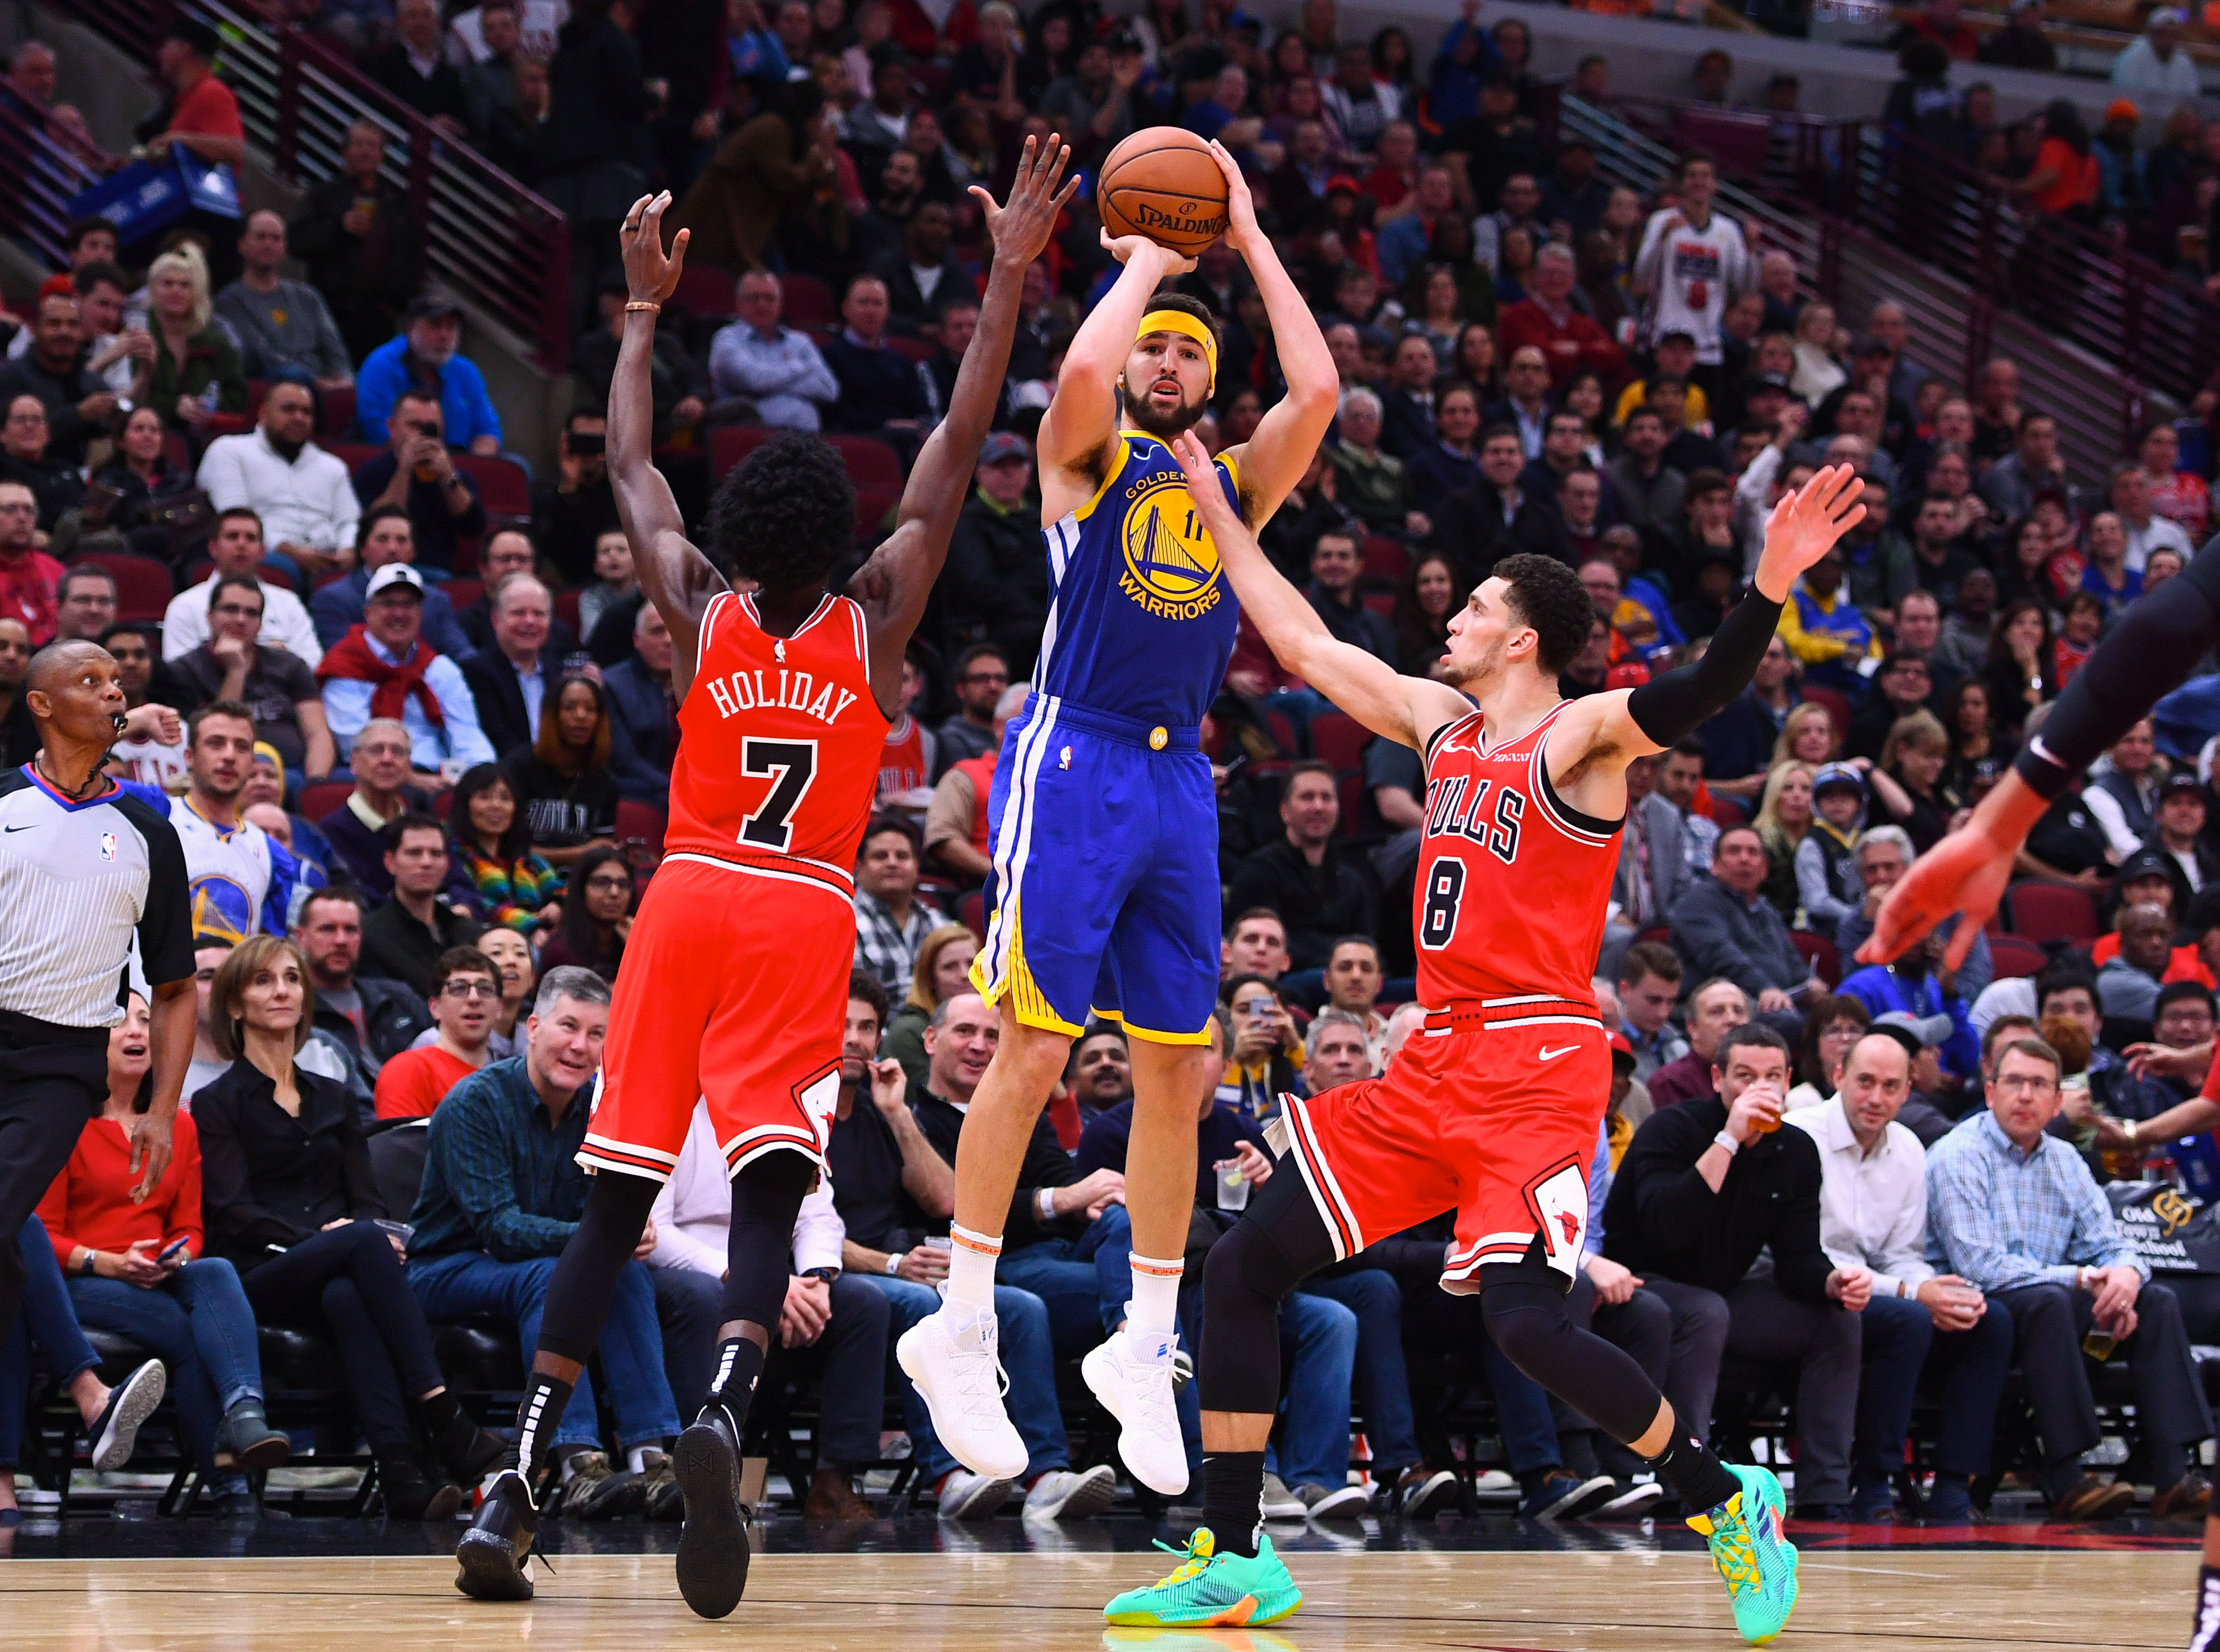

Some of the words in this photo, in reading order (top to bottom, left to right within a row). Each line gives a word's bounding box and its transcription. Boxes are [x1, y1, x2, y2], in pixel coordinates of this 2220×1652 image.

[1135, 203, 1224, 235] SPALDING
[1118, 570, 1220, 621] WARRIORS
[706, 669, 857, 725] HOLIDAY
[736, 736, 818, 854] 7
[1420, 856, 1467, 950] 8
